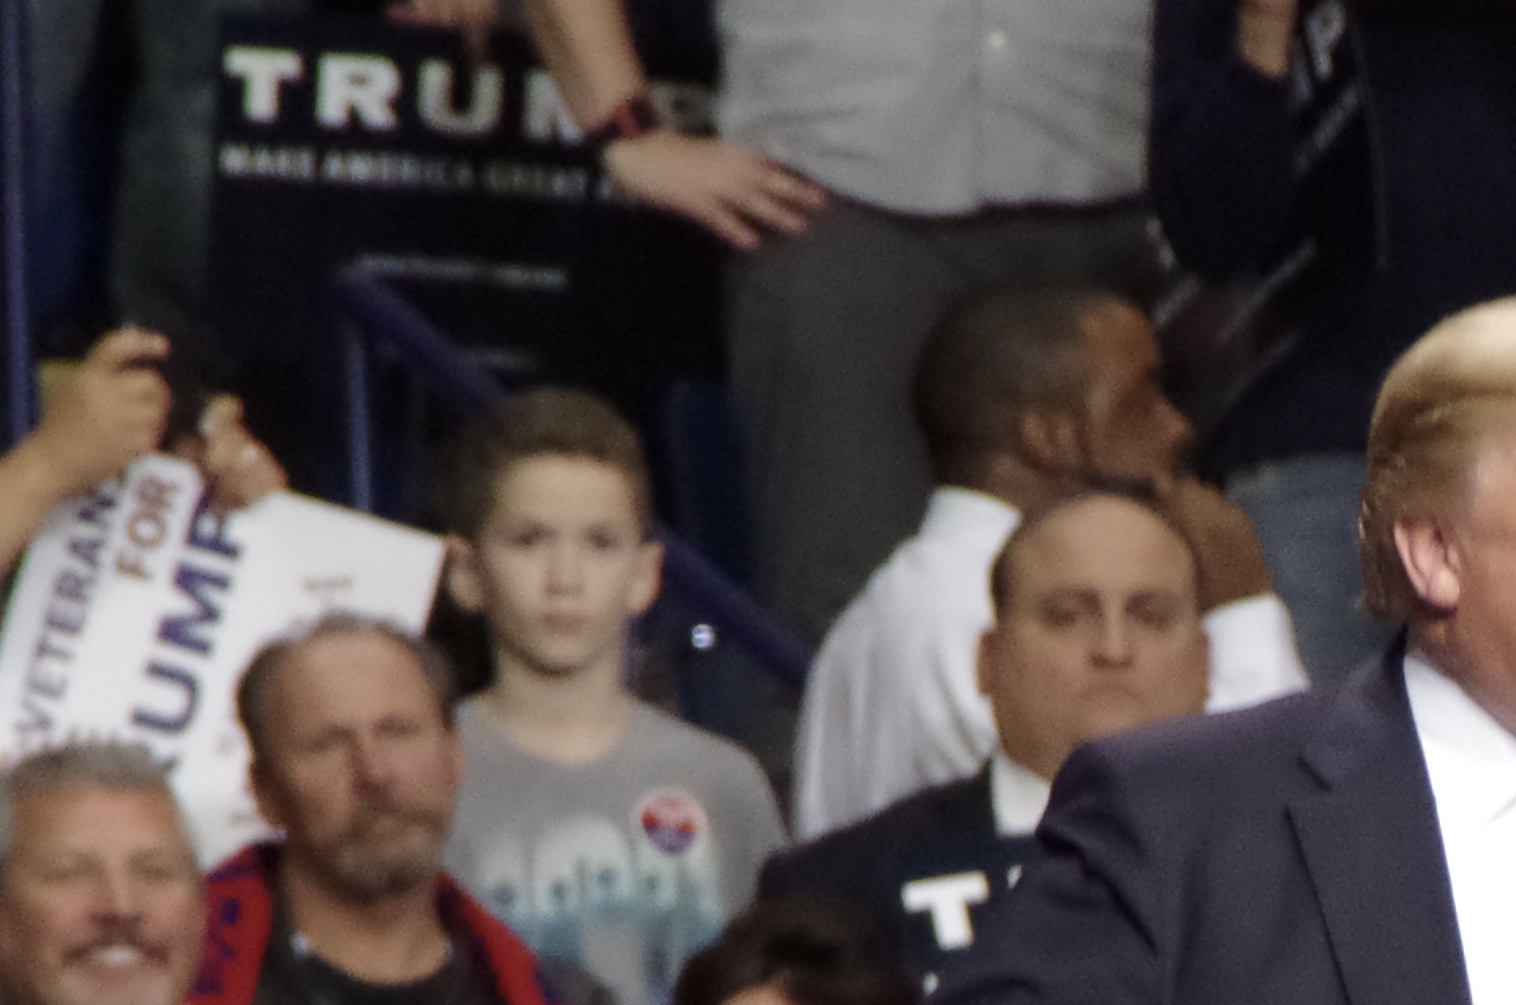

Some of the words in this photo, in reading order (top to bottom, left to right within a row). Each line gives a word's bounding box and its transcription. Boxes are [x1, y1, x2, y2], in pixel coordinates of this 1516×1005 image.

[14, 474, 127, 734] VETERAN
[116, 475, 179, 580] FOR
[131, 489, 242, 768] UMP
